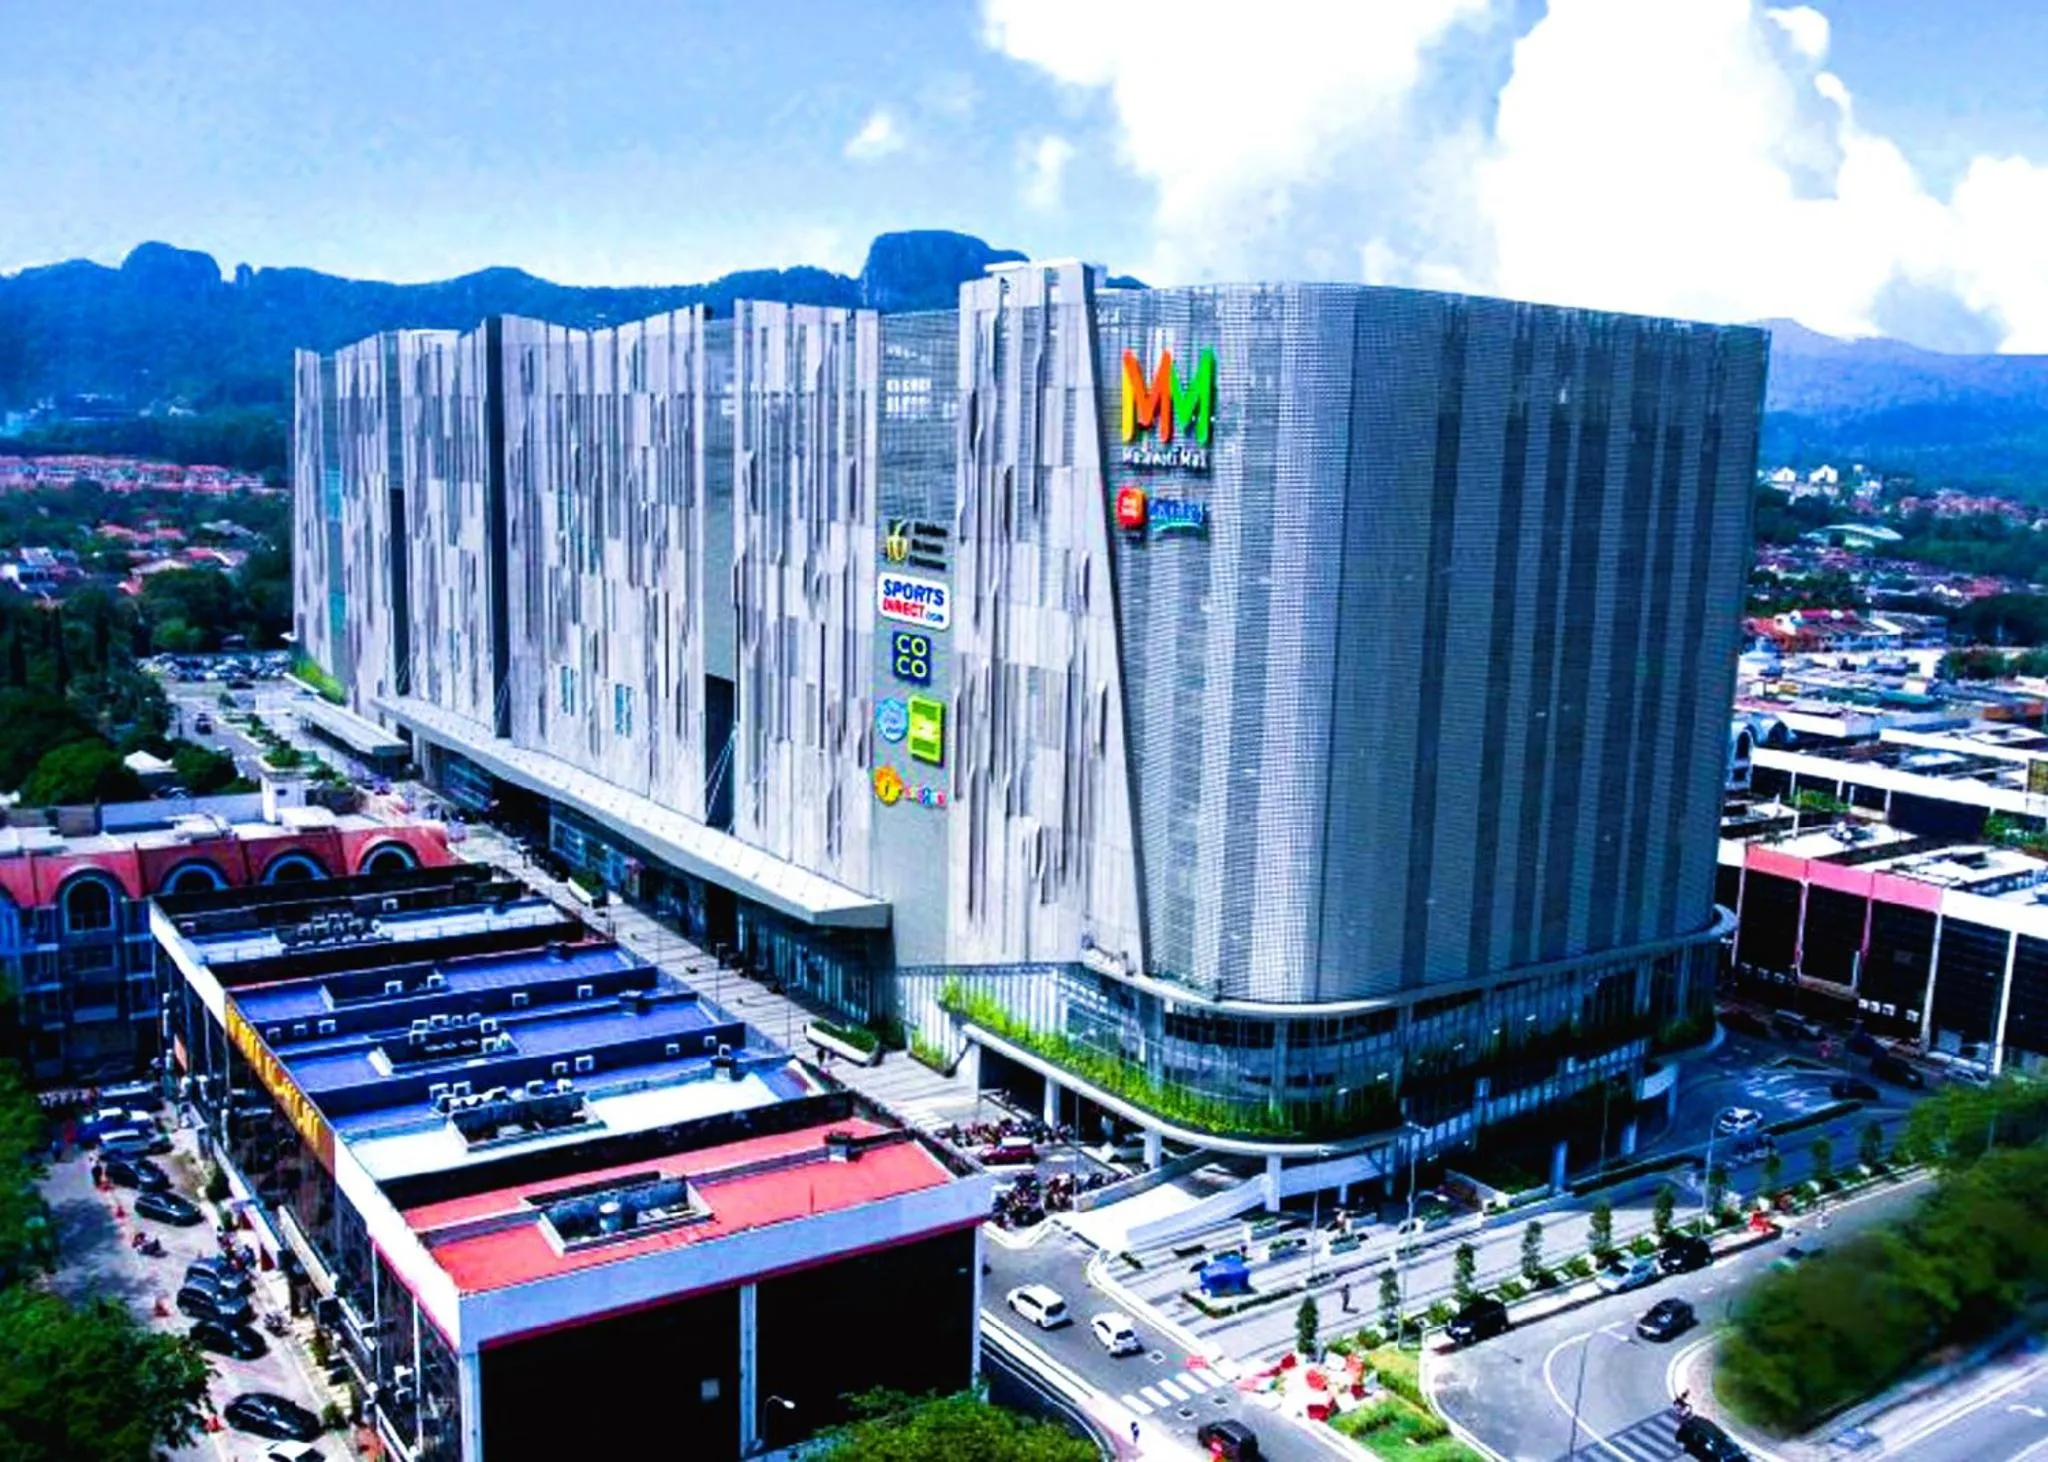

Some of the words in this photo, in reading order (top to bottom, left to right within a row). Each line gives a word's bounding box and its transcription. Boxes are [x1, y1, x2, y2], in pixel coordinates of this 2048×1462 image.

[883, 578, 944, 606] SPORTS
[883, 597, 925, 618] DIRECT
[896, 634, 927, 657] CO
[896, 655, 927, 678] CO
